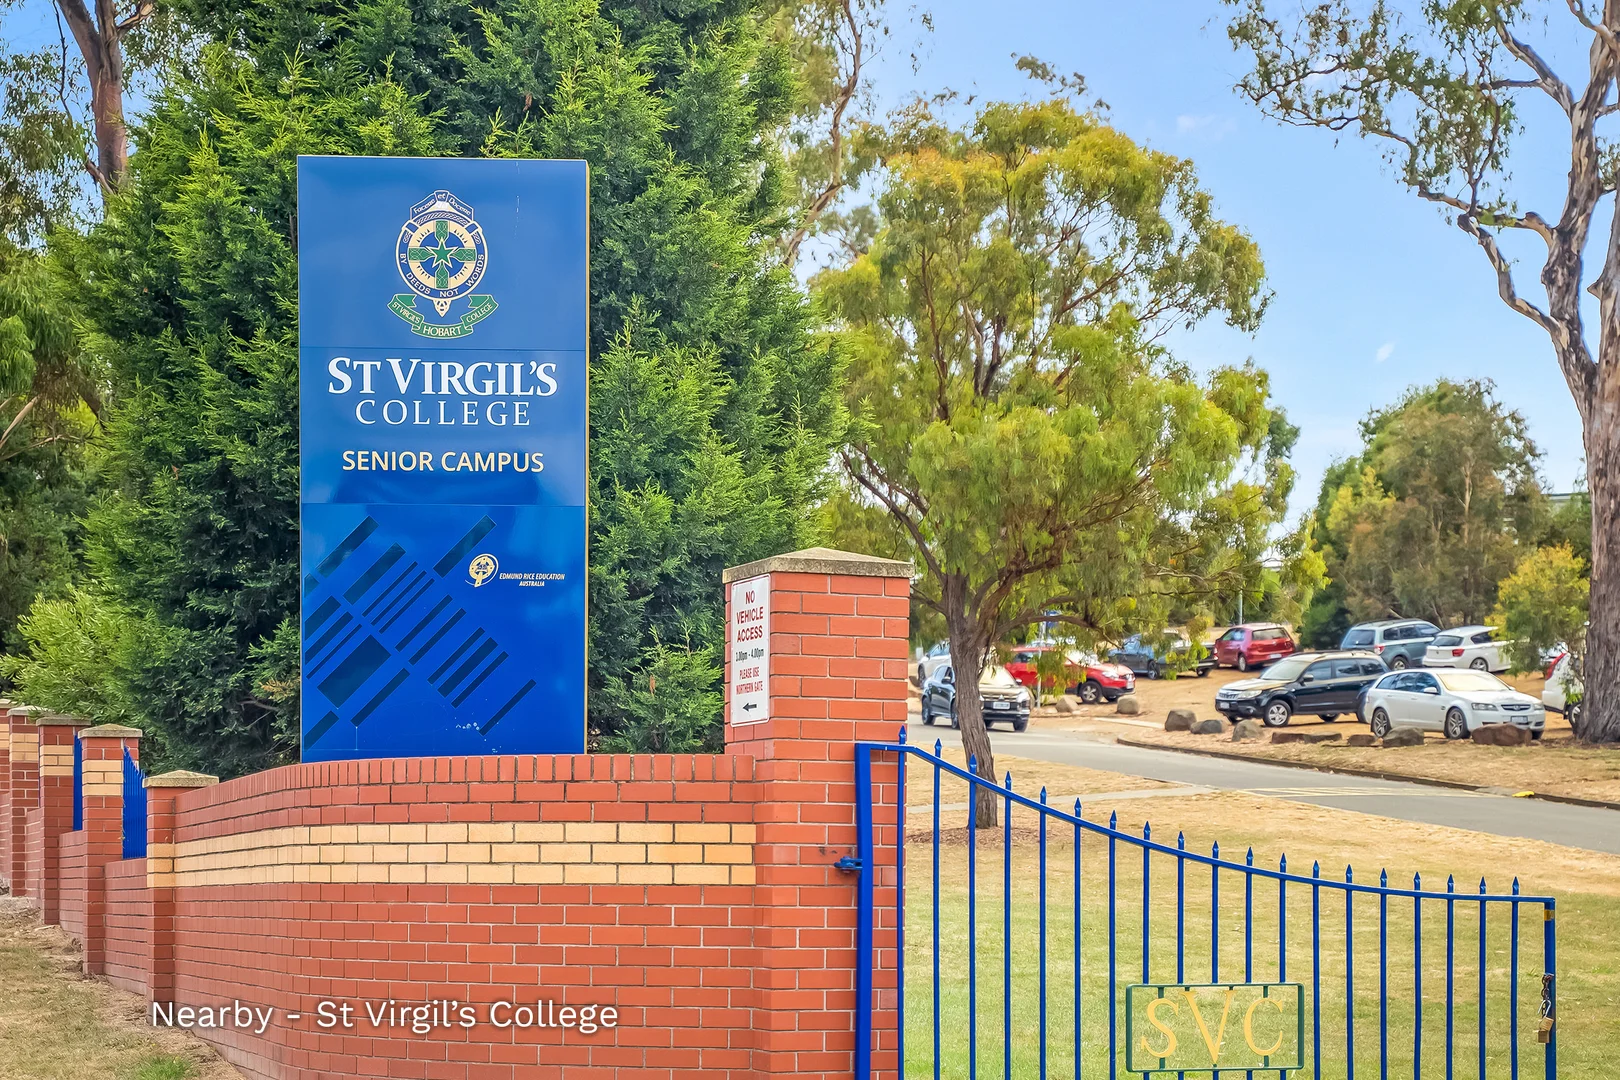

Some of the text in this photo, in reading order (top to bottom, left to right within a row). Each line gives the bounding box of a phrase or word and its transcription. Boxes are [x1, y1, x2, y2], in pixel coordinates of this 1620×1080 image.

[400, 253, 485, 298] BY DEEDS NOT WORDS
[422, 325, 462, 337] HOBART
[466, 302, 493, 323] COLLEGE
[327, 357, 558, 397] ST VIRGIL'S
[355, 399, 531, 426] COLLEGE
[342, 450, 545, 473] SENIOR CAMPUS
[499, 572, 523, 580] EDMUND
[535, 573, 565, 581] EDUCATION
[745, 591, 755, 604] NO
[736, 606, 764, 624] VEHICLE
[737, 625, 764, 643] ACCESS
[739, 668, 752, 680] PLEASE
[1140, 990, 1284, 1065] SVC
